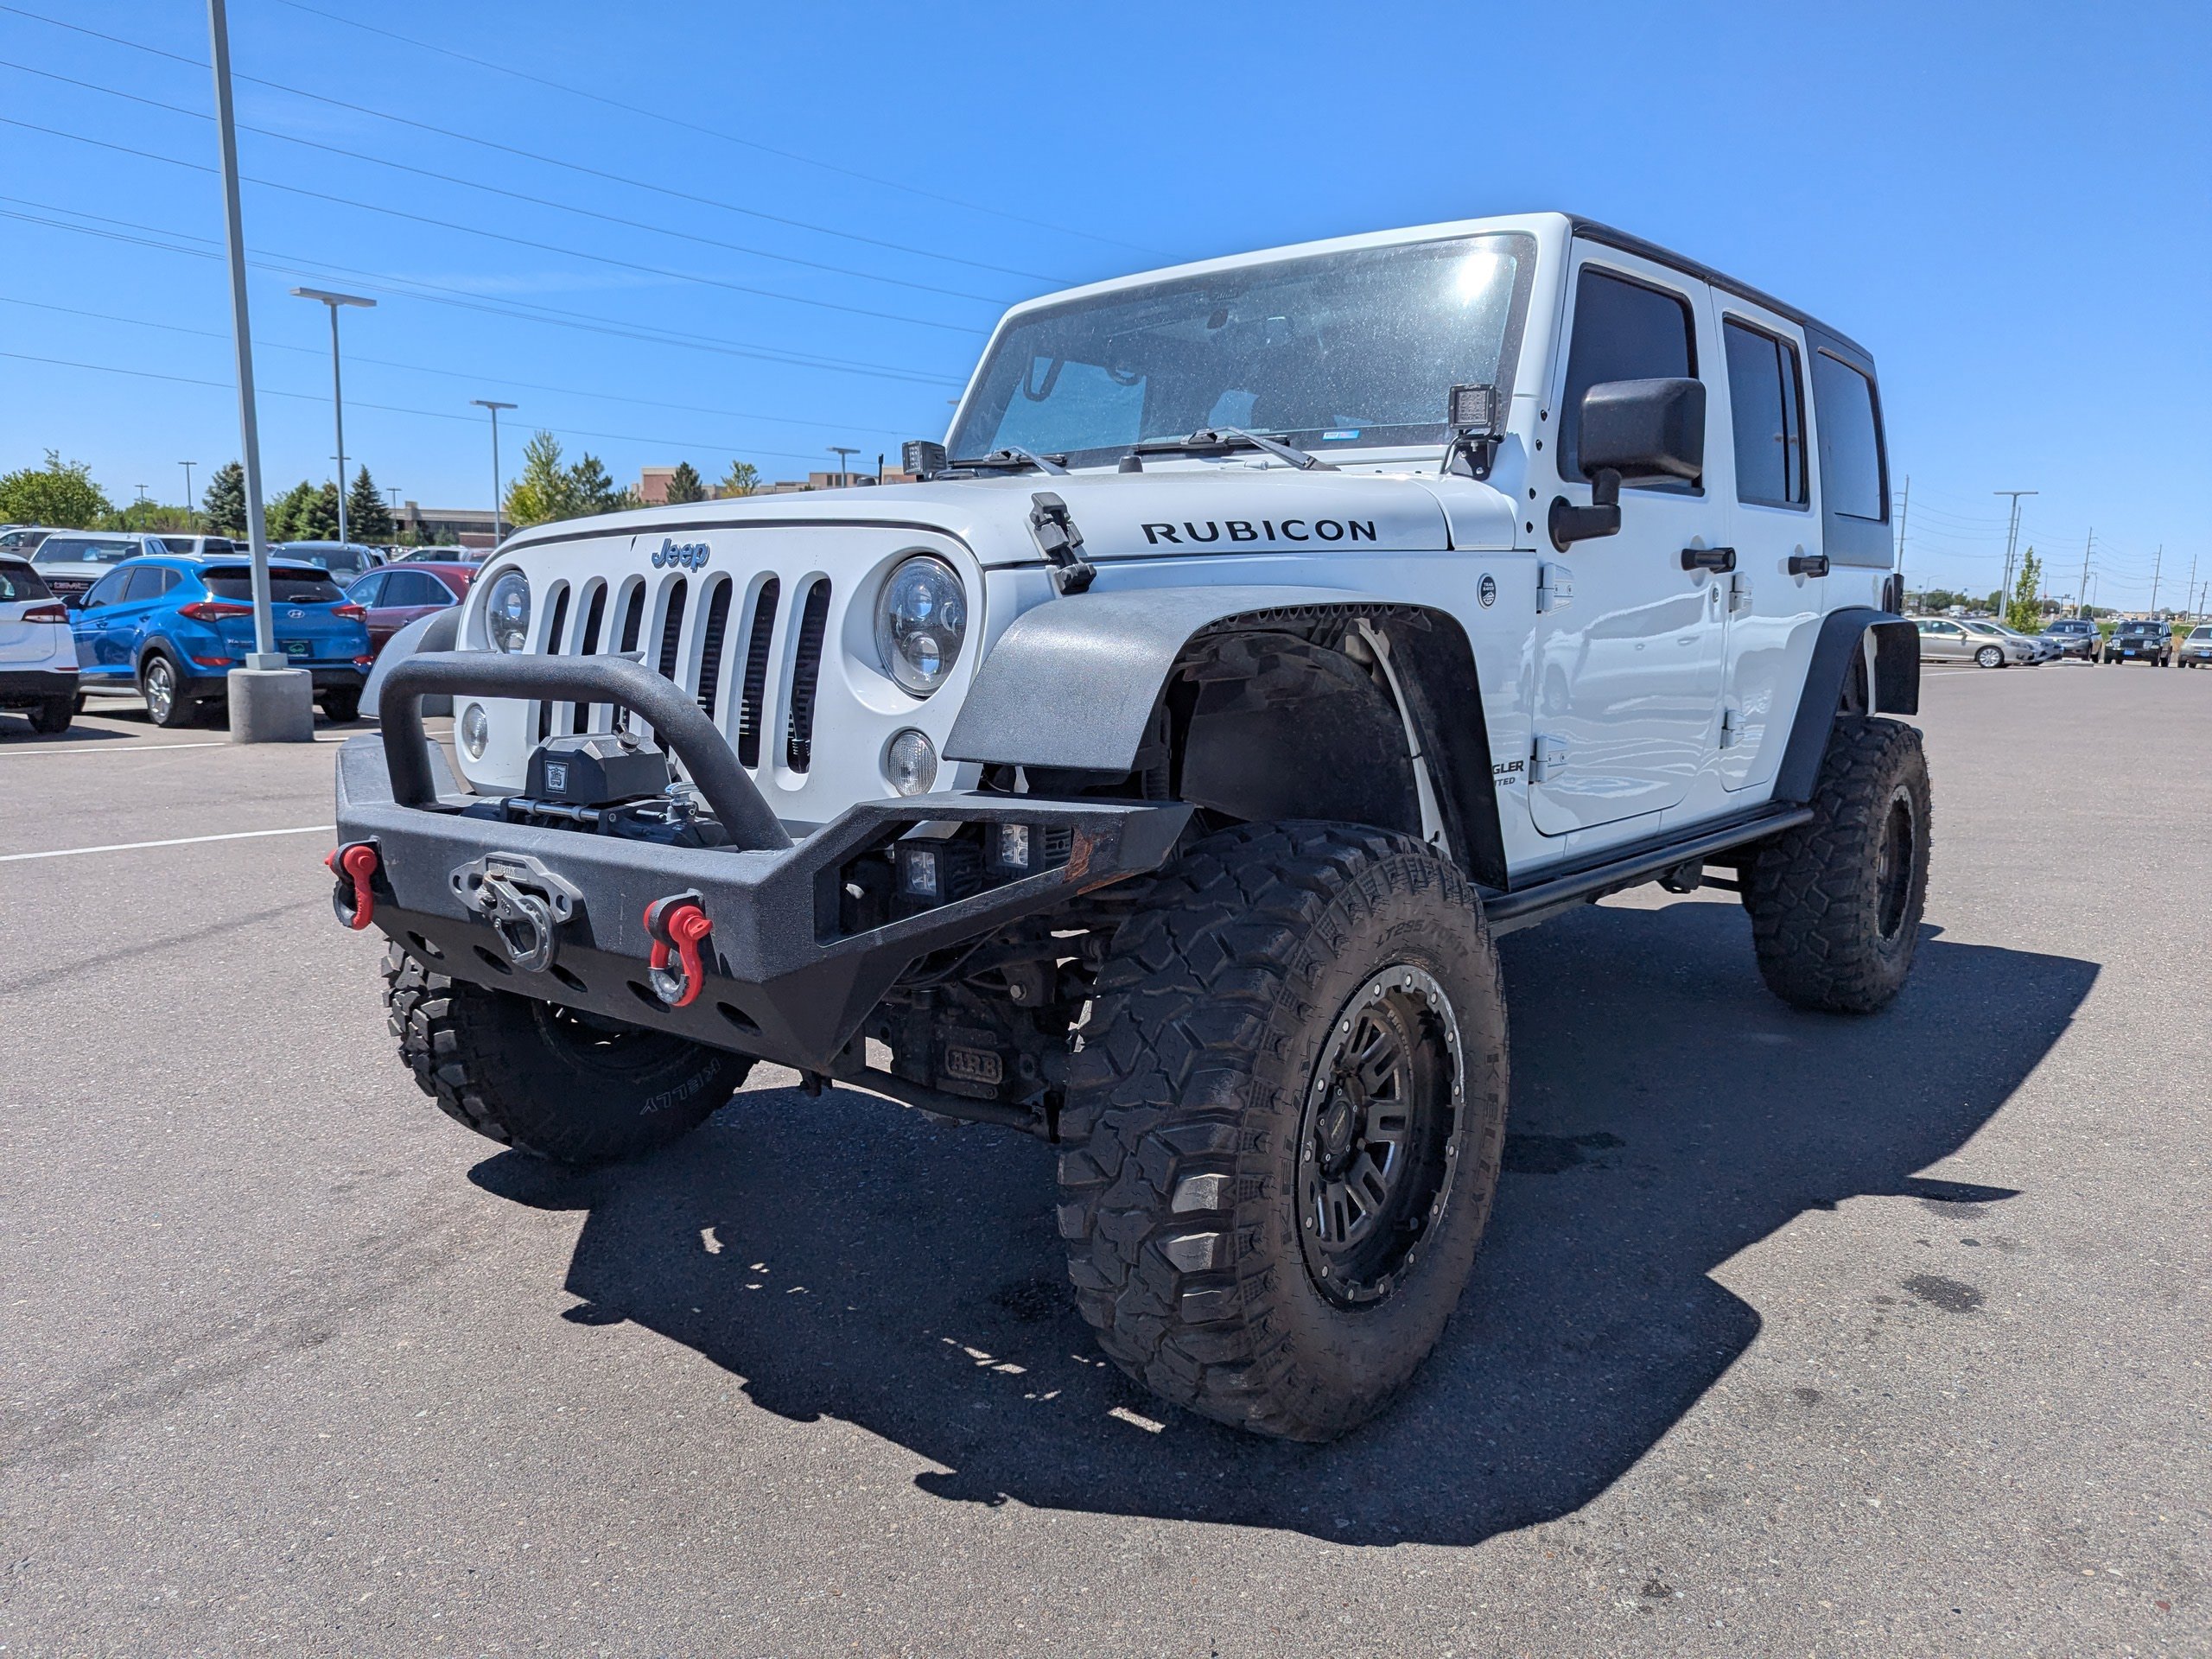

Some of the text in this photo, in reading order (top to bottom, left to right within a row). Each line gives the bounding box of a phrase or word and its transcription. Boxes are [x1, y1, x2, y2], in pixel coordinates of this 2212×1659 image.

[1140, 518, 1377, 545] RUBICON
[651, 537, 711, 574] Jeep
[950, 1051, 997, 1077] ARB
[639, 1056, 721, 1116] KELLY
[1471, 1052, 1501, 1220] KELLY
